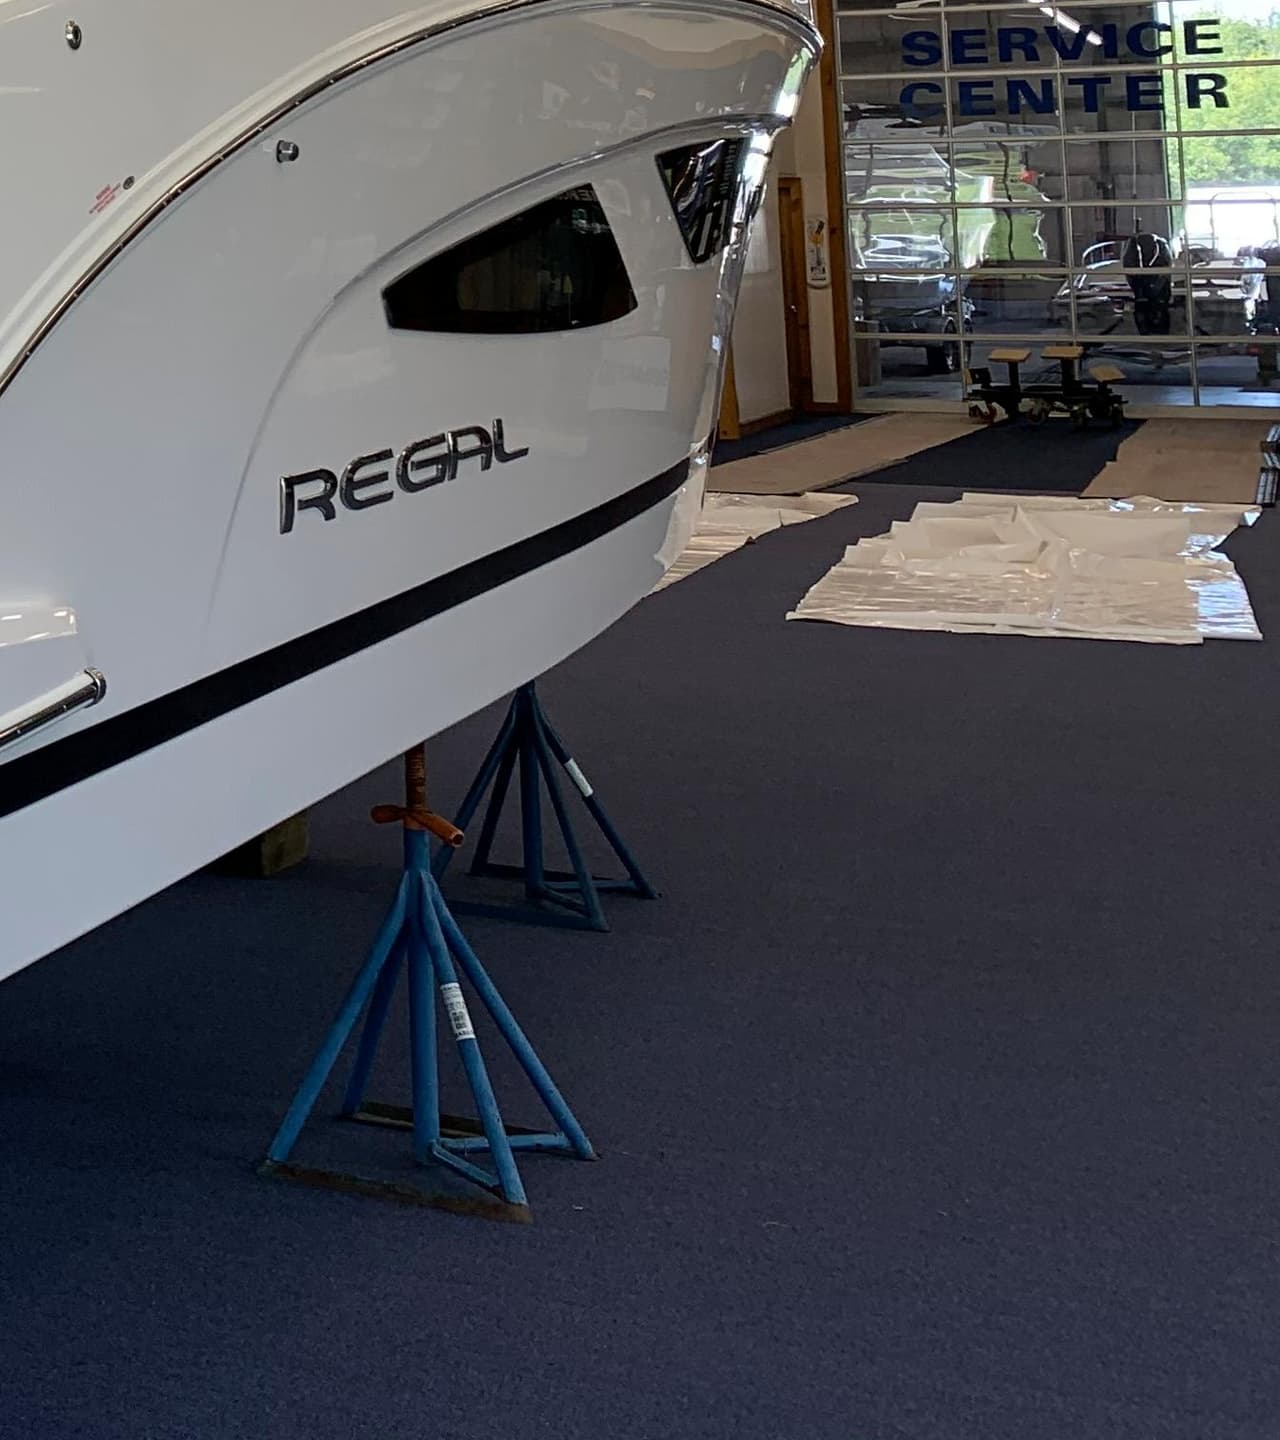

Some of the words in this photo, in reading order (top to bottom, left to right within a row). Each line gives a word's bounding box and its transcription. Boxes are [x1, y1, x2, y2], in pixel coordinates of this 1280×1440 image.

[901, 19, 1224, 66] SERVICE
[899, 72, 1230, 118] CENTER
[279, 418, 529, 535] REGAL
